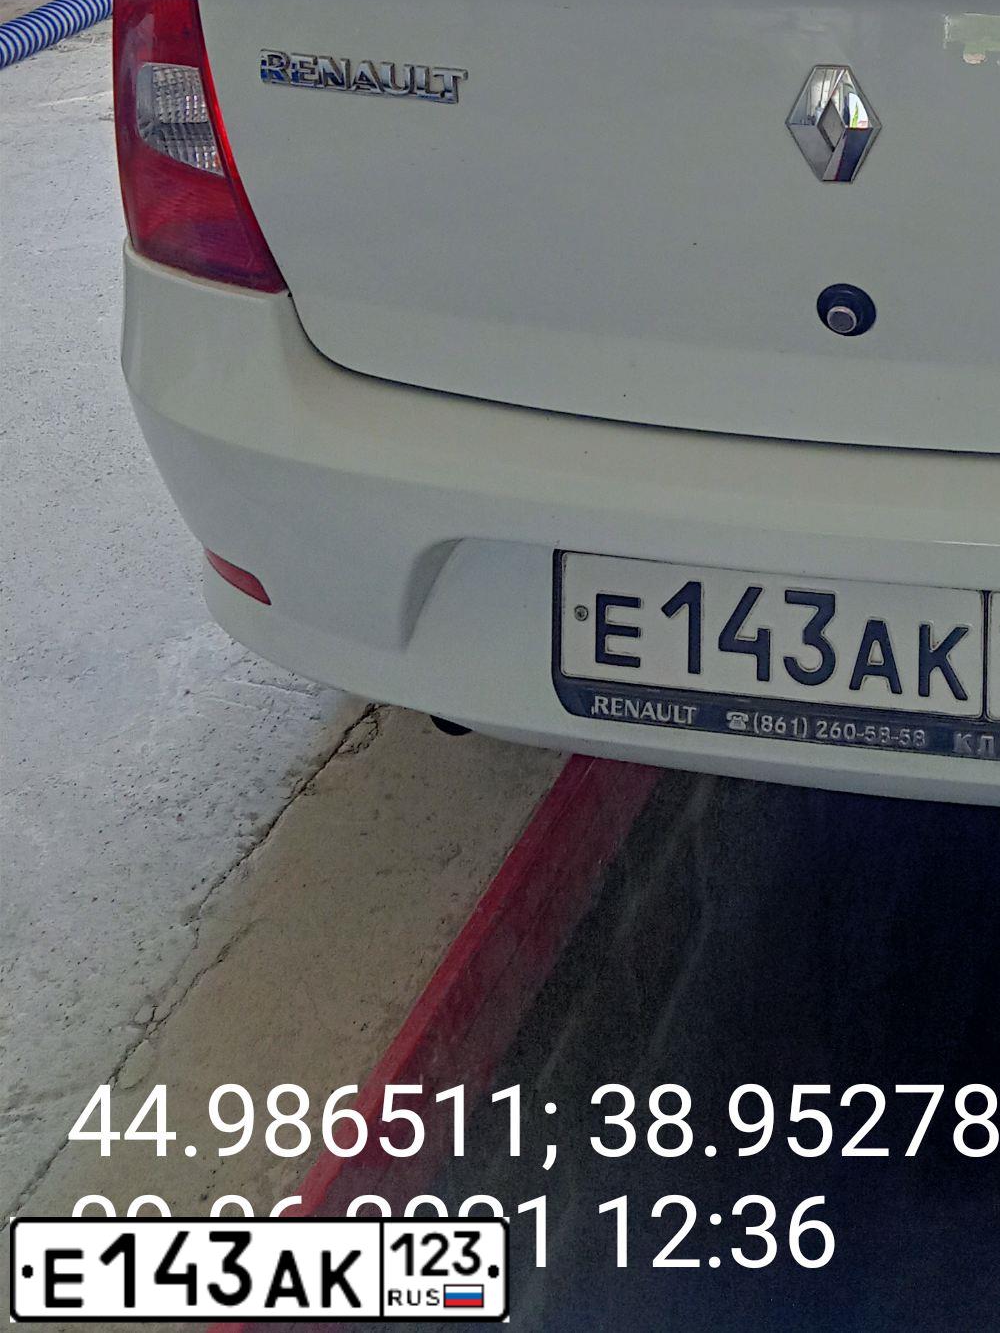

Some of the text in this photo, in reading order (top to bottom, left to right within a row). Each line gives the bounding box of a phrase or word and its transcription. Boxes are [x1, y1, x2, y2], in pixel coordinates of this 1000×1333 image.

[259, 48, 469, 104] RENAULT
[592, 695, 697, 725] RENAULT
[753, 711, 808, 739] (861)
